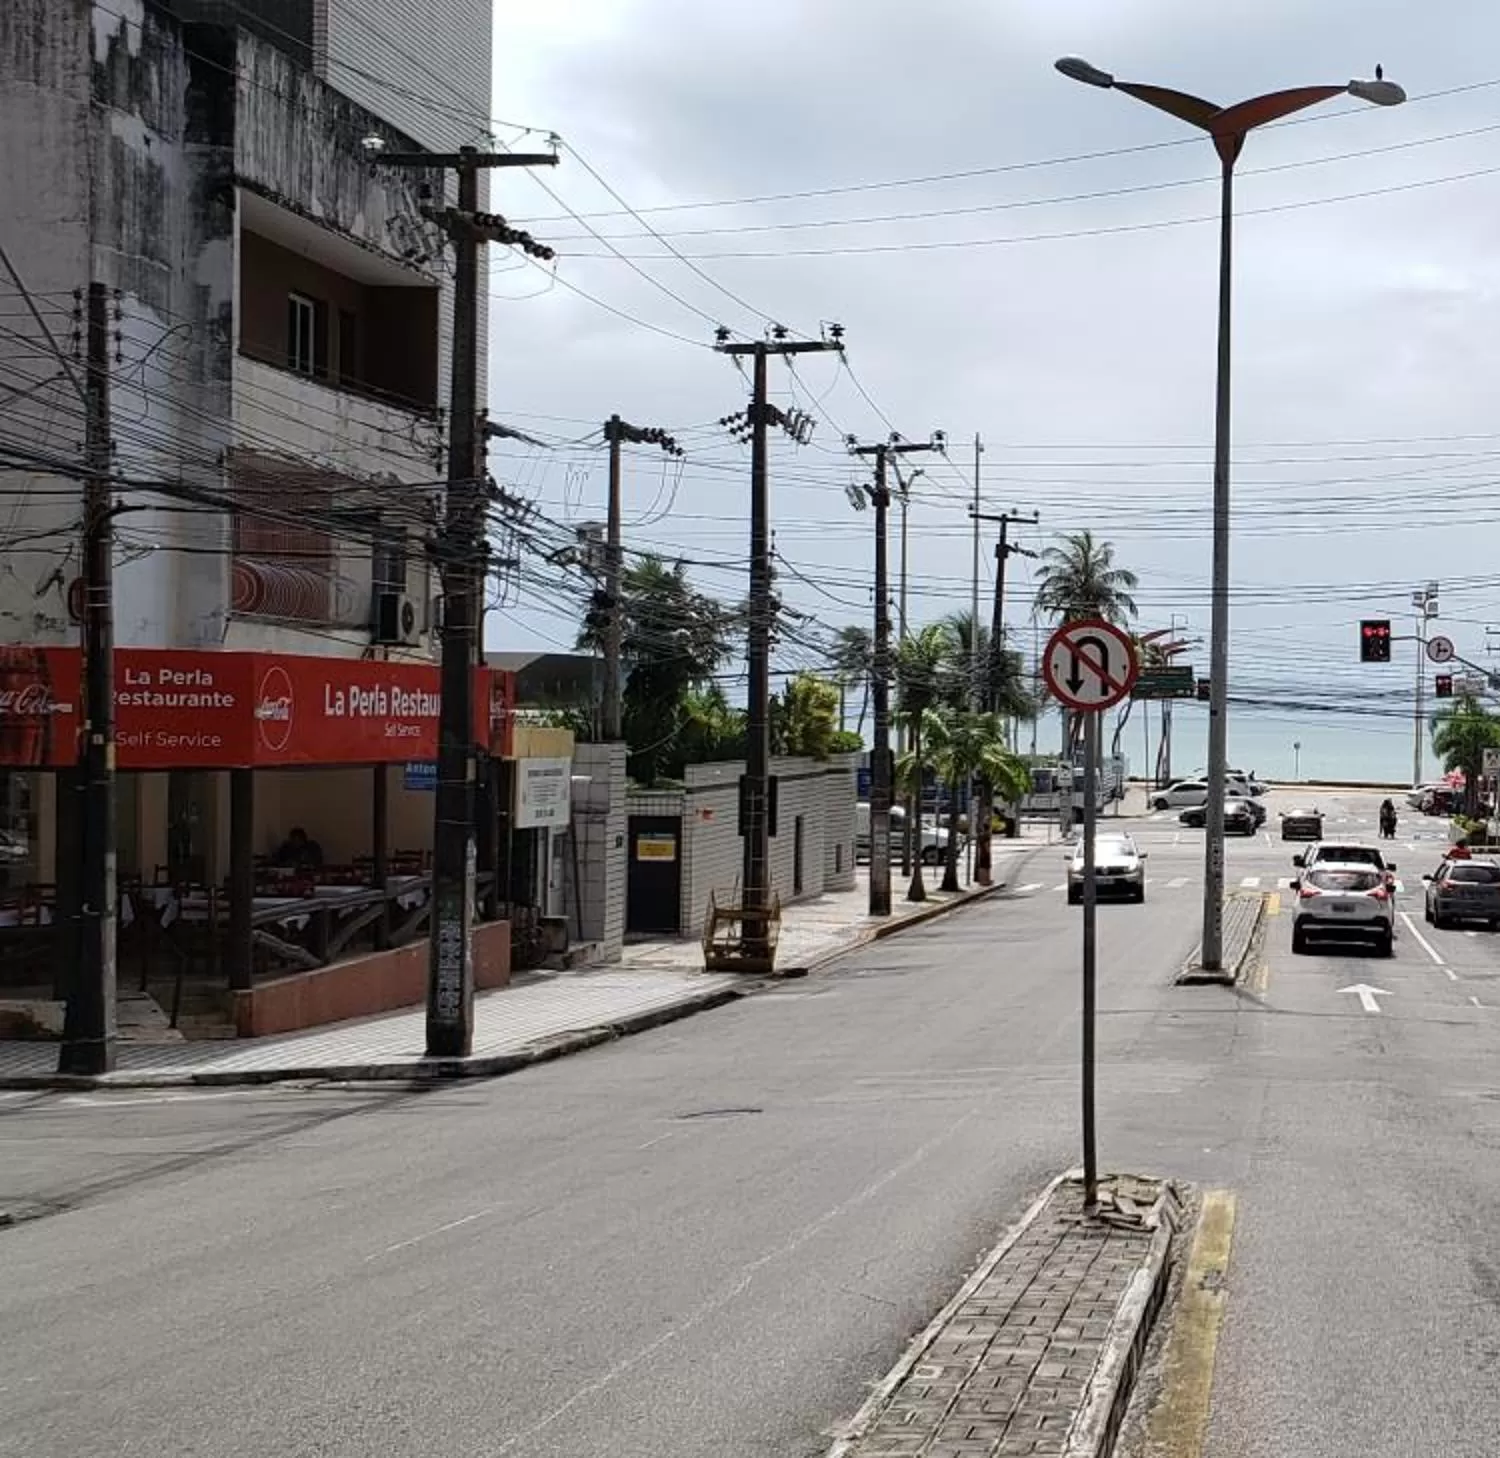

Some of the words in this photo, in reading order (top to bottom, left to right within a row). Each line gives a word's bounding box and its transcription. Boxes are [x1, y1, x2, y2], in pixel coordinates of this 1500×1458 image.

[124, 667, 151, 685] La
[159, 668, 213, 686] Perla
[324, 683, 345, 717] La
[350, 683, 386, 718] Perla
[391, 685, 441, 718] Restaur
[116, 729, 152, 747] Self
[156, 729, 222, 748] Service
